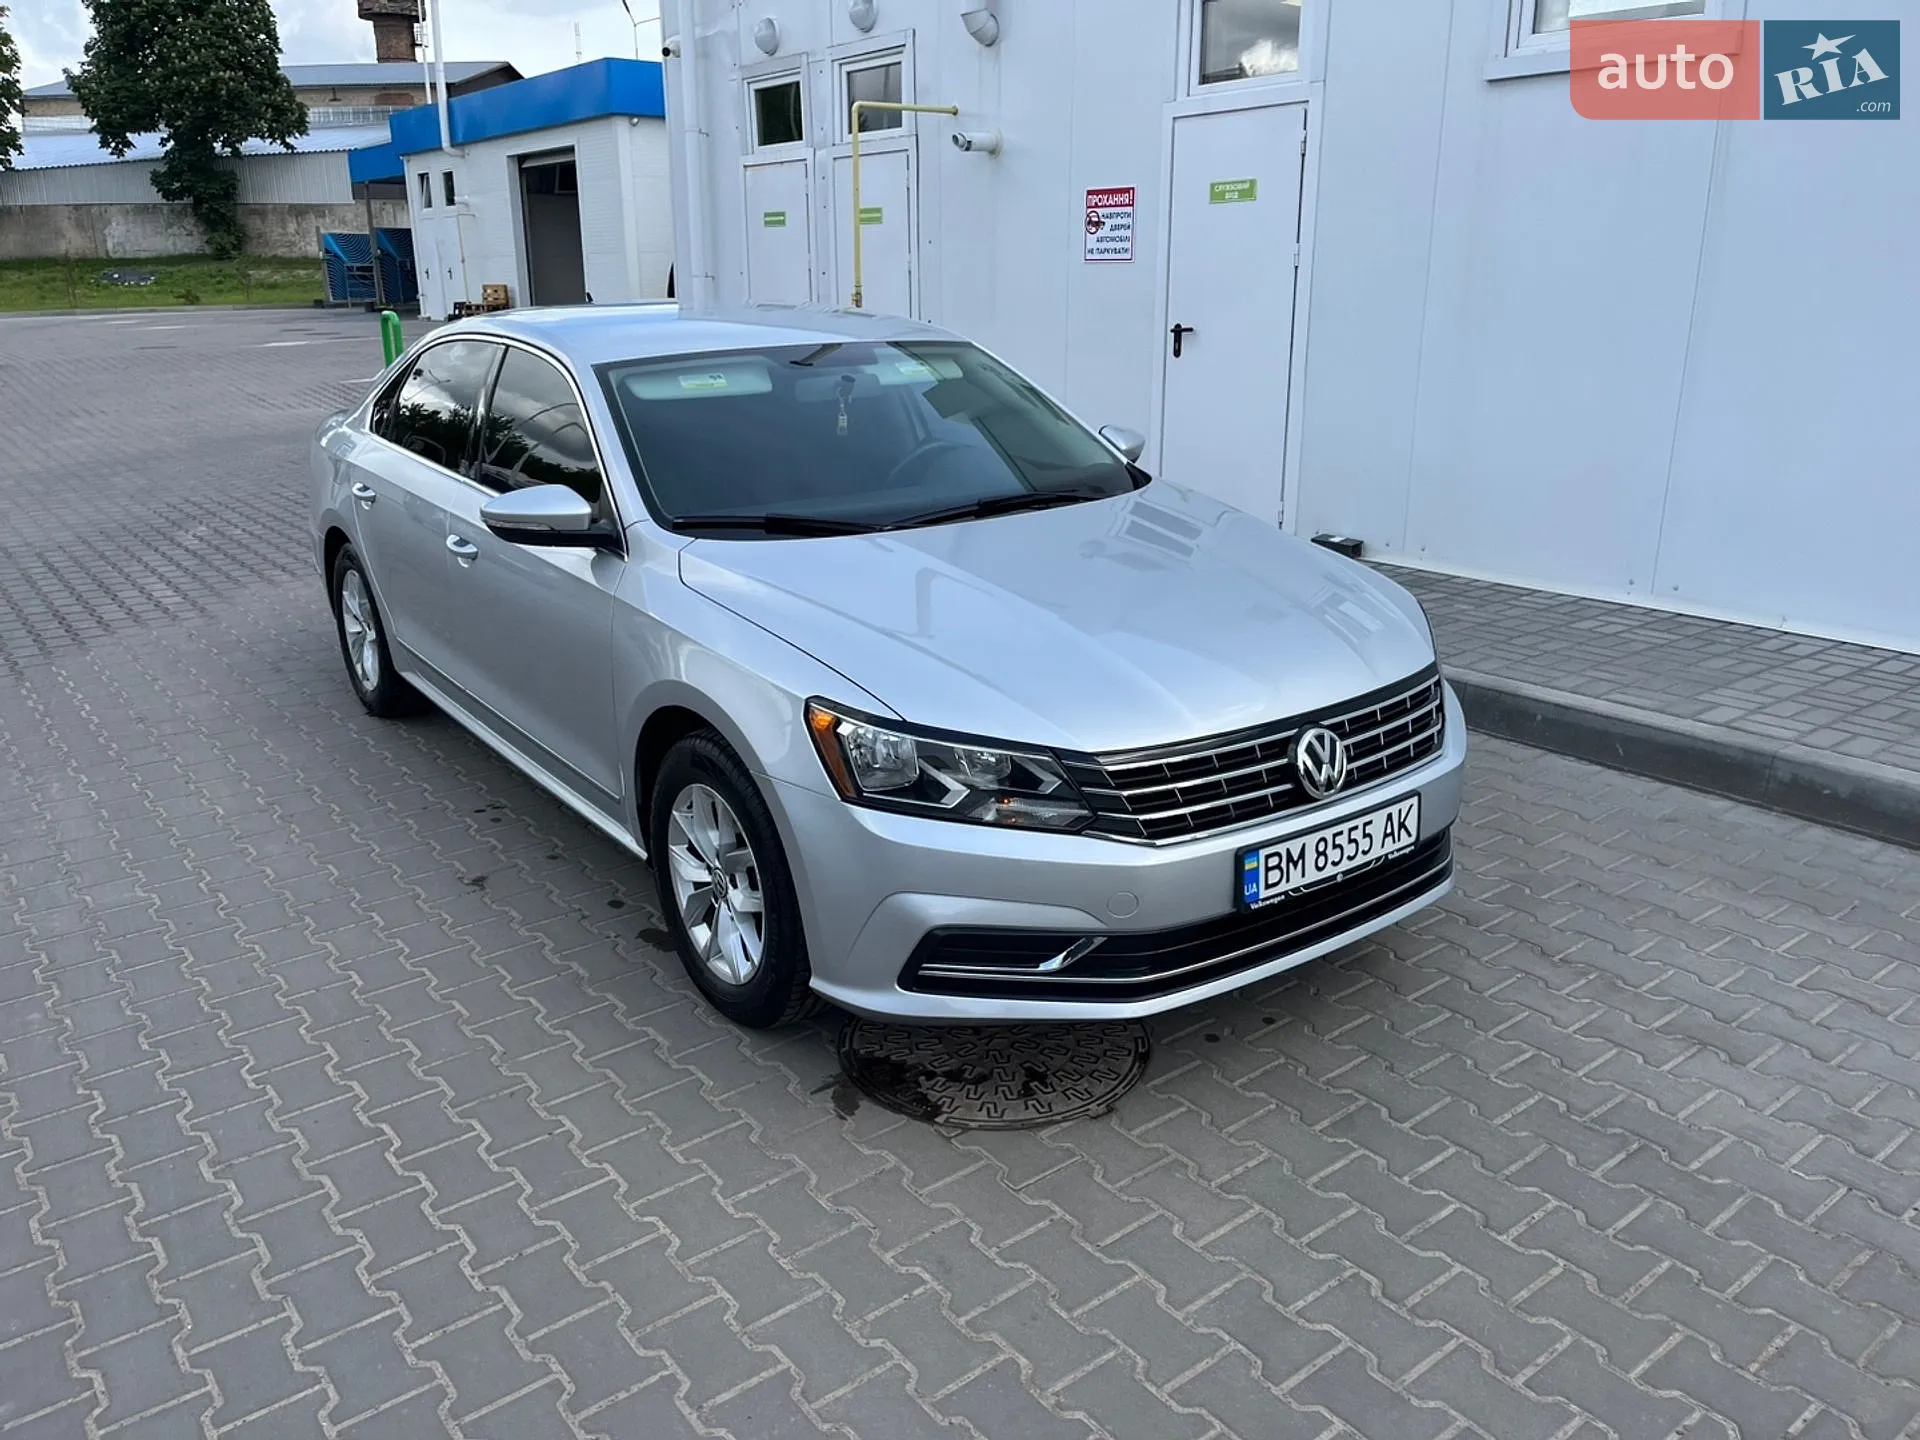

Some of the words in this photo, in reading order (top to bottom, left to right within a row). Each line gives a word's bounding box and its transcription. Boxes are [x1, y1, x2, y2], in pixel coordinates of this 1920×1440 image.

[1087, 189, 1133, 207] ПРОХАННЯ!
[1101, 211, 1131, 220] НАВПРОТИ
[1109, 222, 1131, 232] ДВЕРЕЙ
[1087, 247, 1095, 255] НЕ
[1264, 842, 1306, 891] BM
[1314, 819, 1374, 873] 8555
[1381, 803, 1415, 849] AK
[1244, 883, 1258, 896] UA
